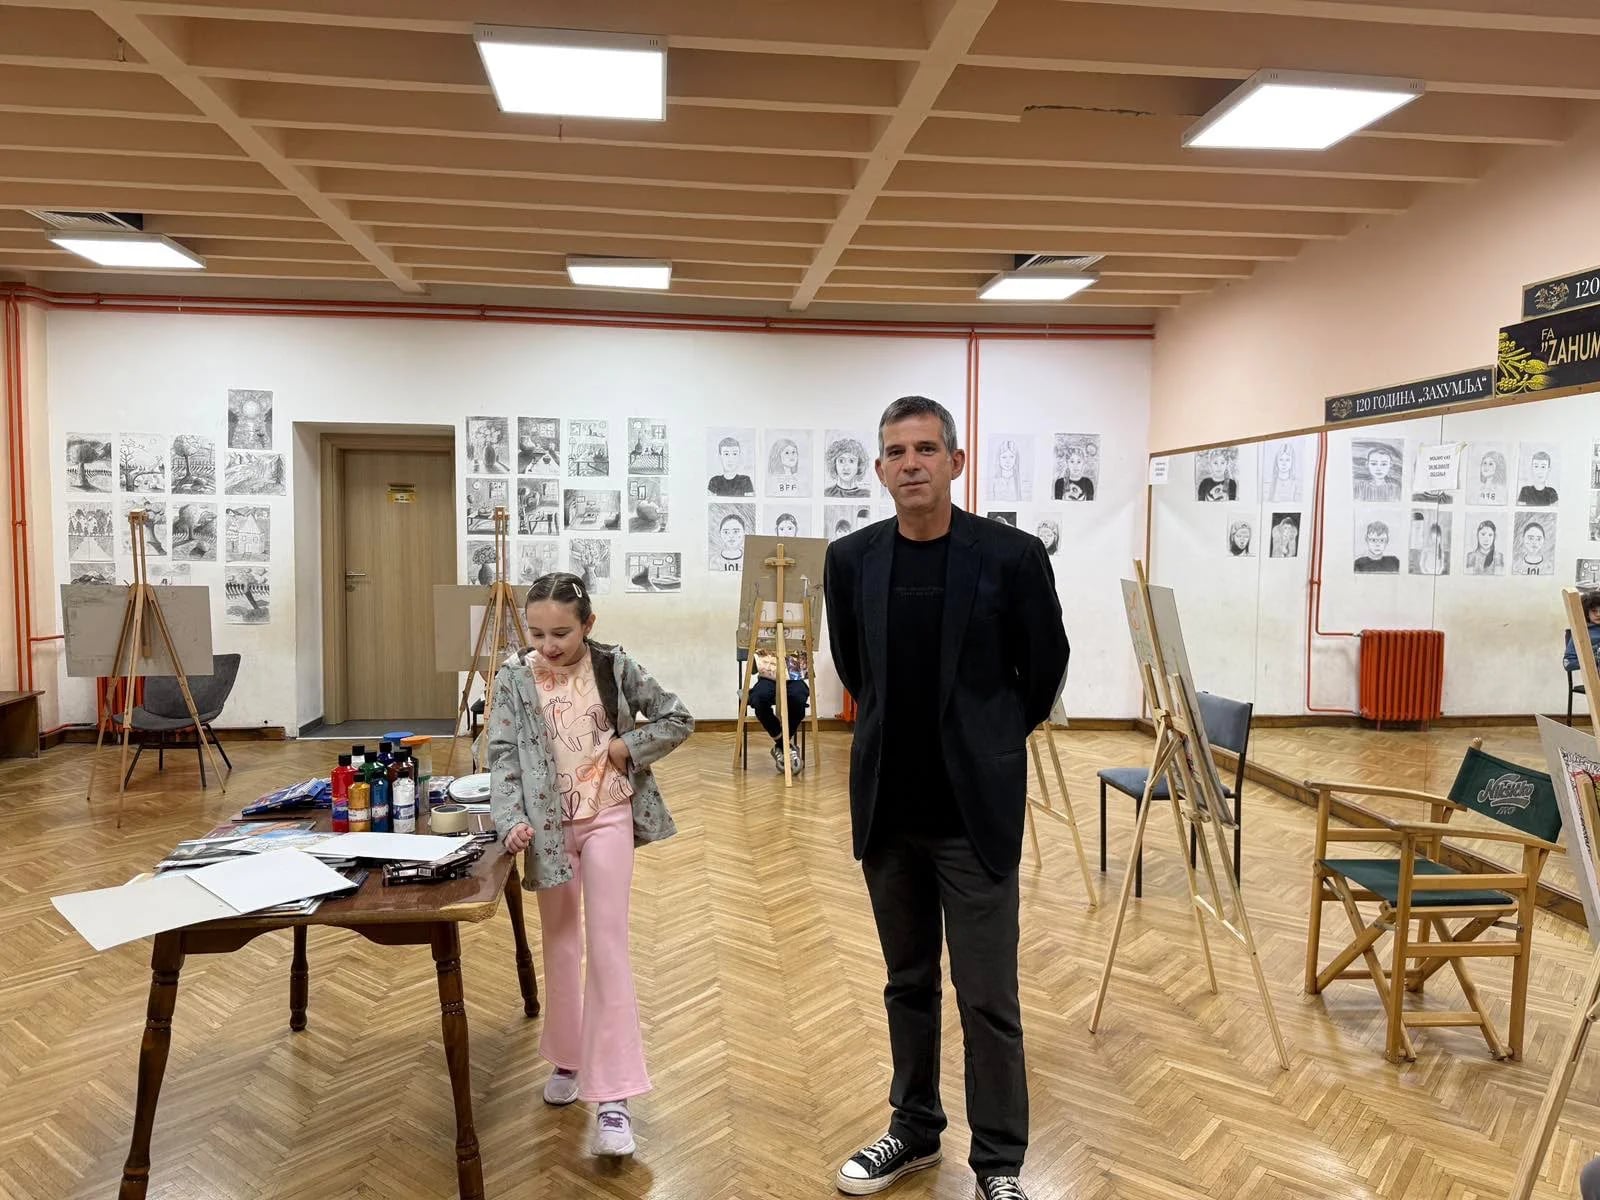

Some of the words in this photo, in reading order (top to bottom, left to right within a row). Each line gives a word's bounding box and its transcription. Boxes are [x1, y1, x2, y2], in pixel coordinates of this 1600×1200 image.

[1575, 277, 1600, 299] 120
[1541, 328, 1555, 340] FA
[1356, 397, 1371, 413] 120
[1372, 389, 1416, 410] ГОДИНА
